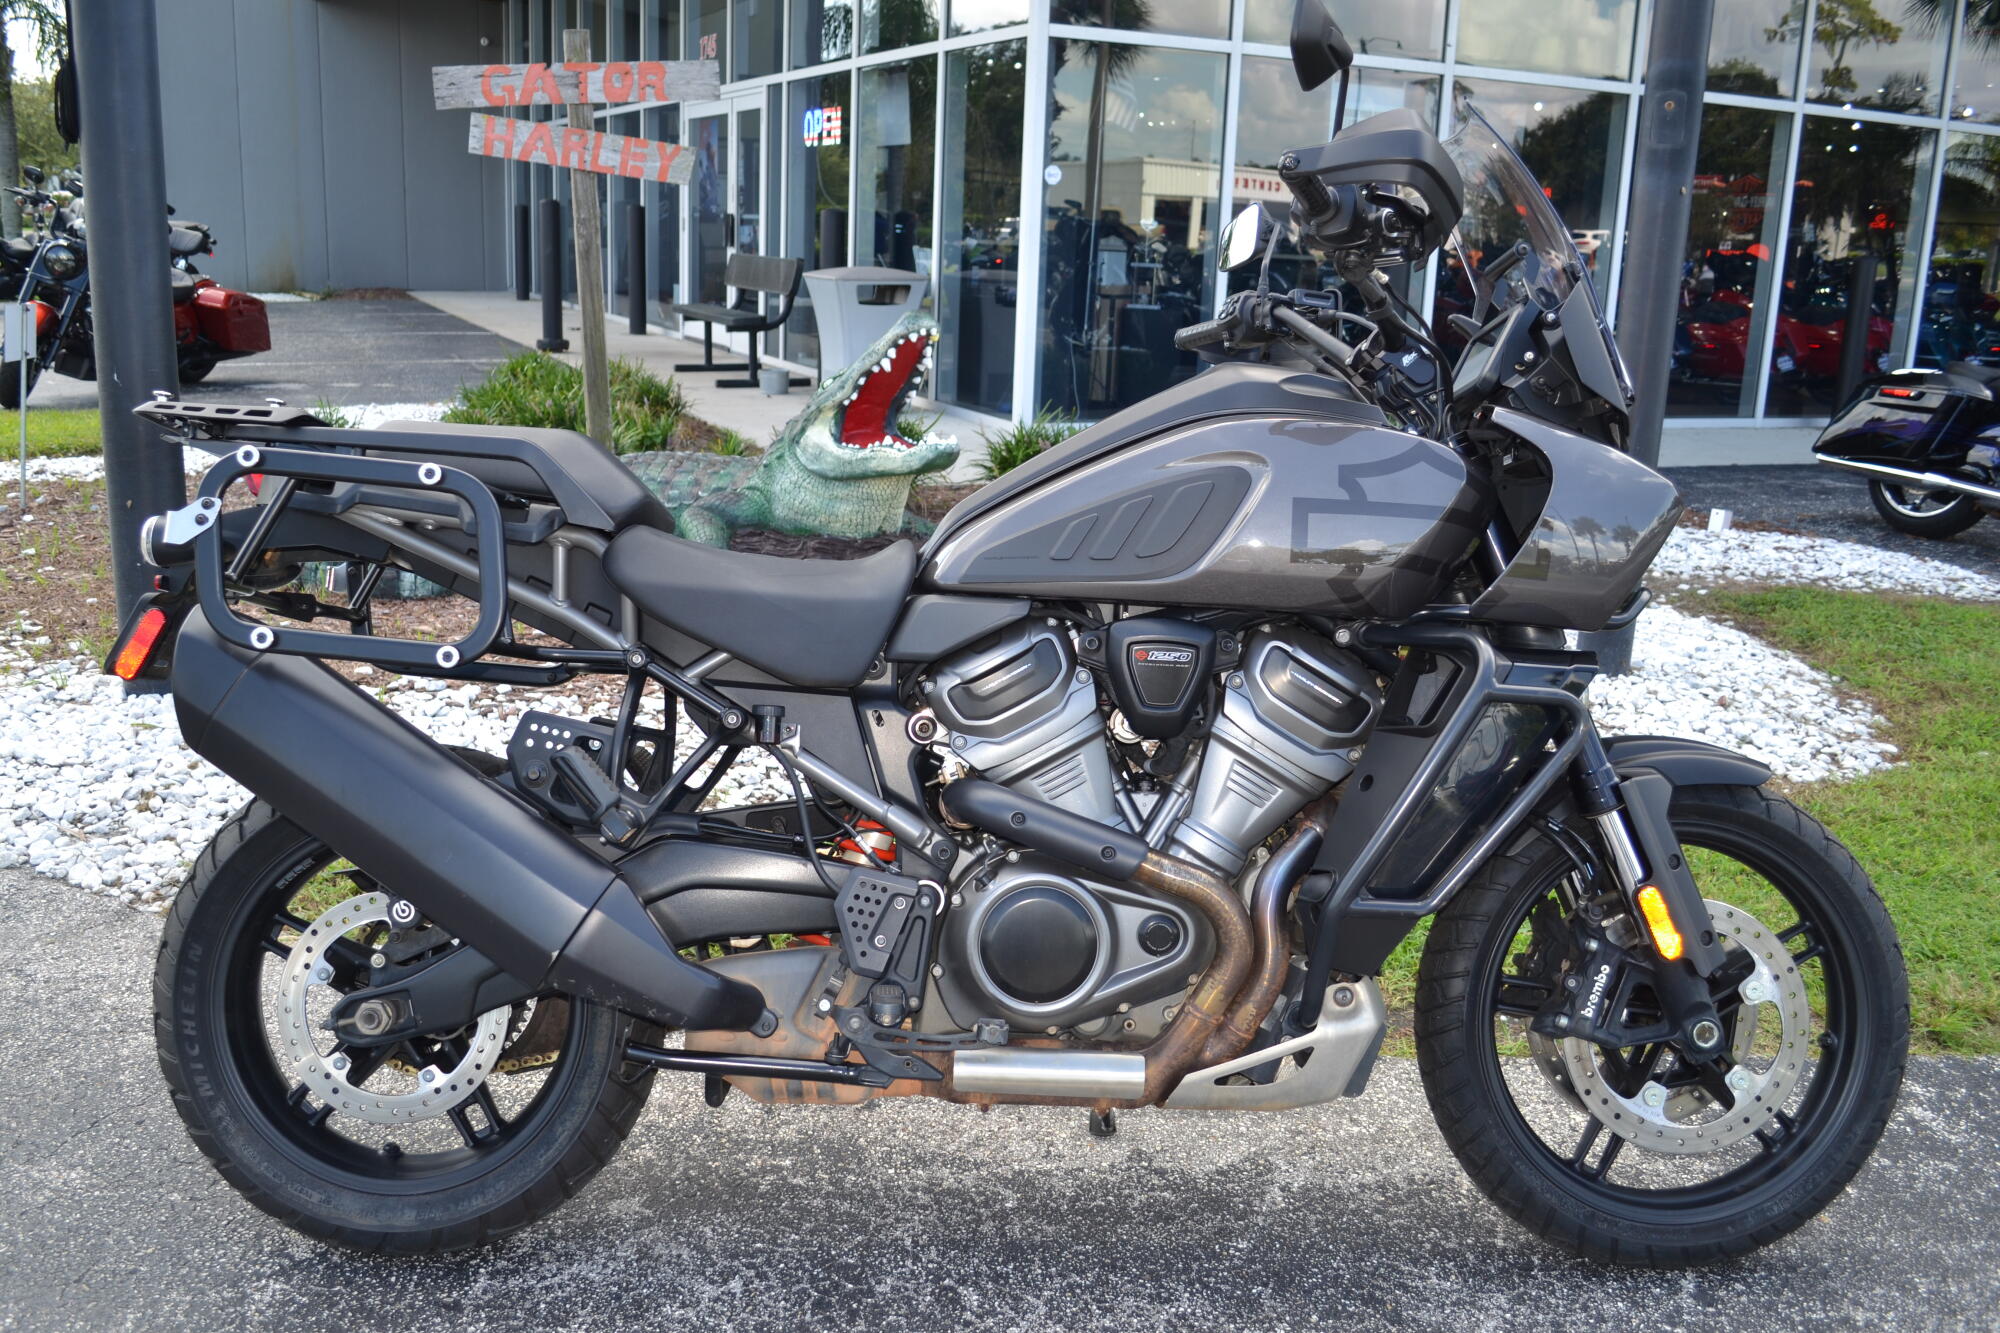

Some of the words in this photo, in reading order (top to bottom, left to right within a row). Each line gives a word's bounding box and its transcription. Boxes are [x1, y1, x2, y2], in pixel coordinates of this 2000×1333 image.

[481, 61, 669, 106] GATOR
[483, 114, 683, 183] HARLEY
[803, 106, 842, 147] OPEN
[1148, 650, 1191, 661] 1250
[1580, 964, 1610, 1018] brembo
[181, 942, 215, 1096] MICHELIN
